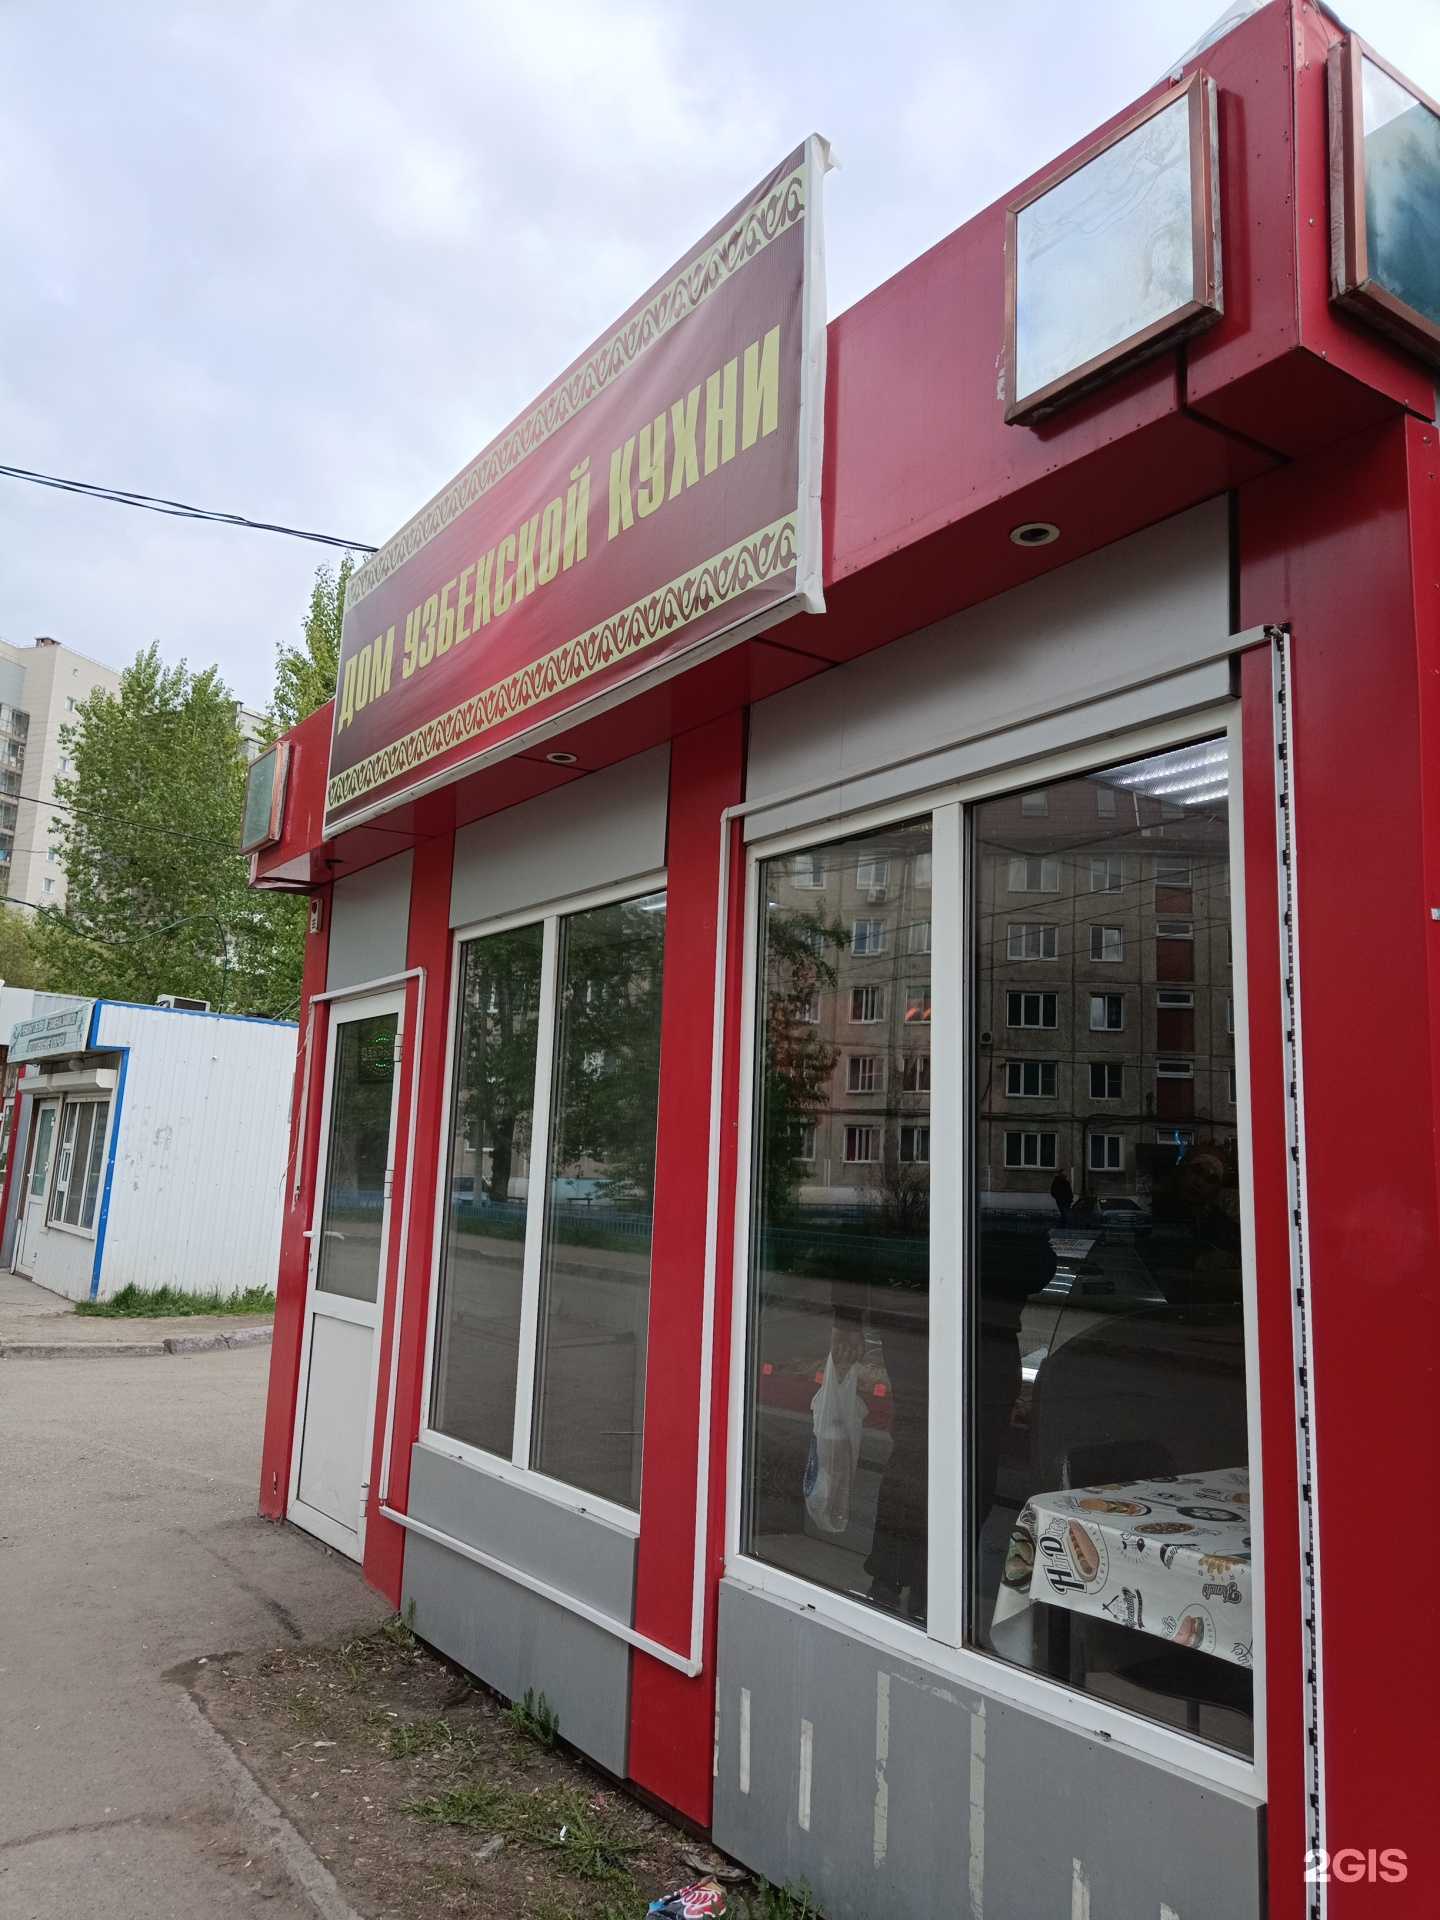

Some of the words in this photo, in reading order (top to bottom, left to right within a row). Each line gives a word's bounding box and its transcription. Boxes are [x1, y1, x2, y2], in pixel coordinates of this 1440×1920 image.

[337, 624, 395, 735] ДОМ
[402, 456, 591, 680] УЗБЕКСКОЙ
[608, 324, 780, 541] КУХНИ
